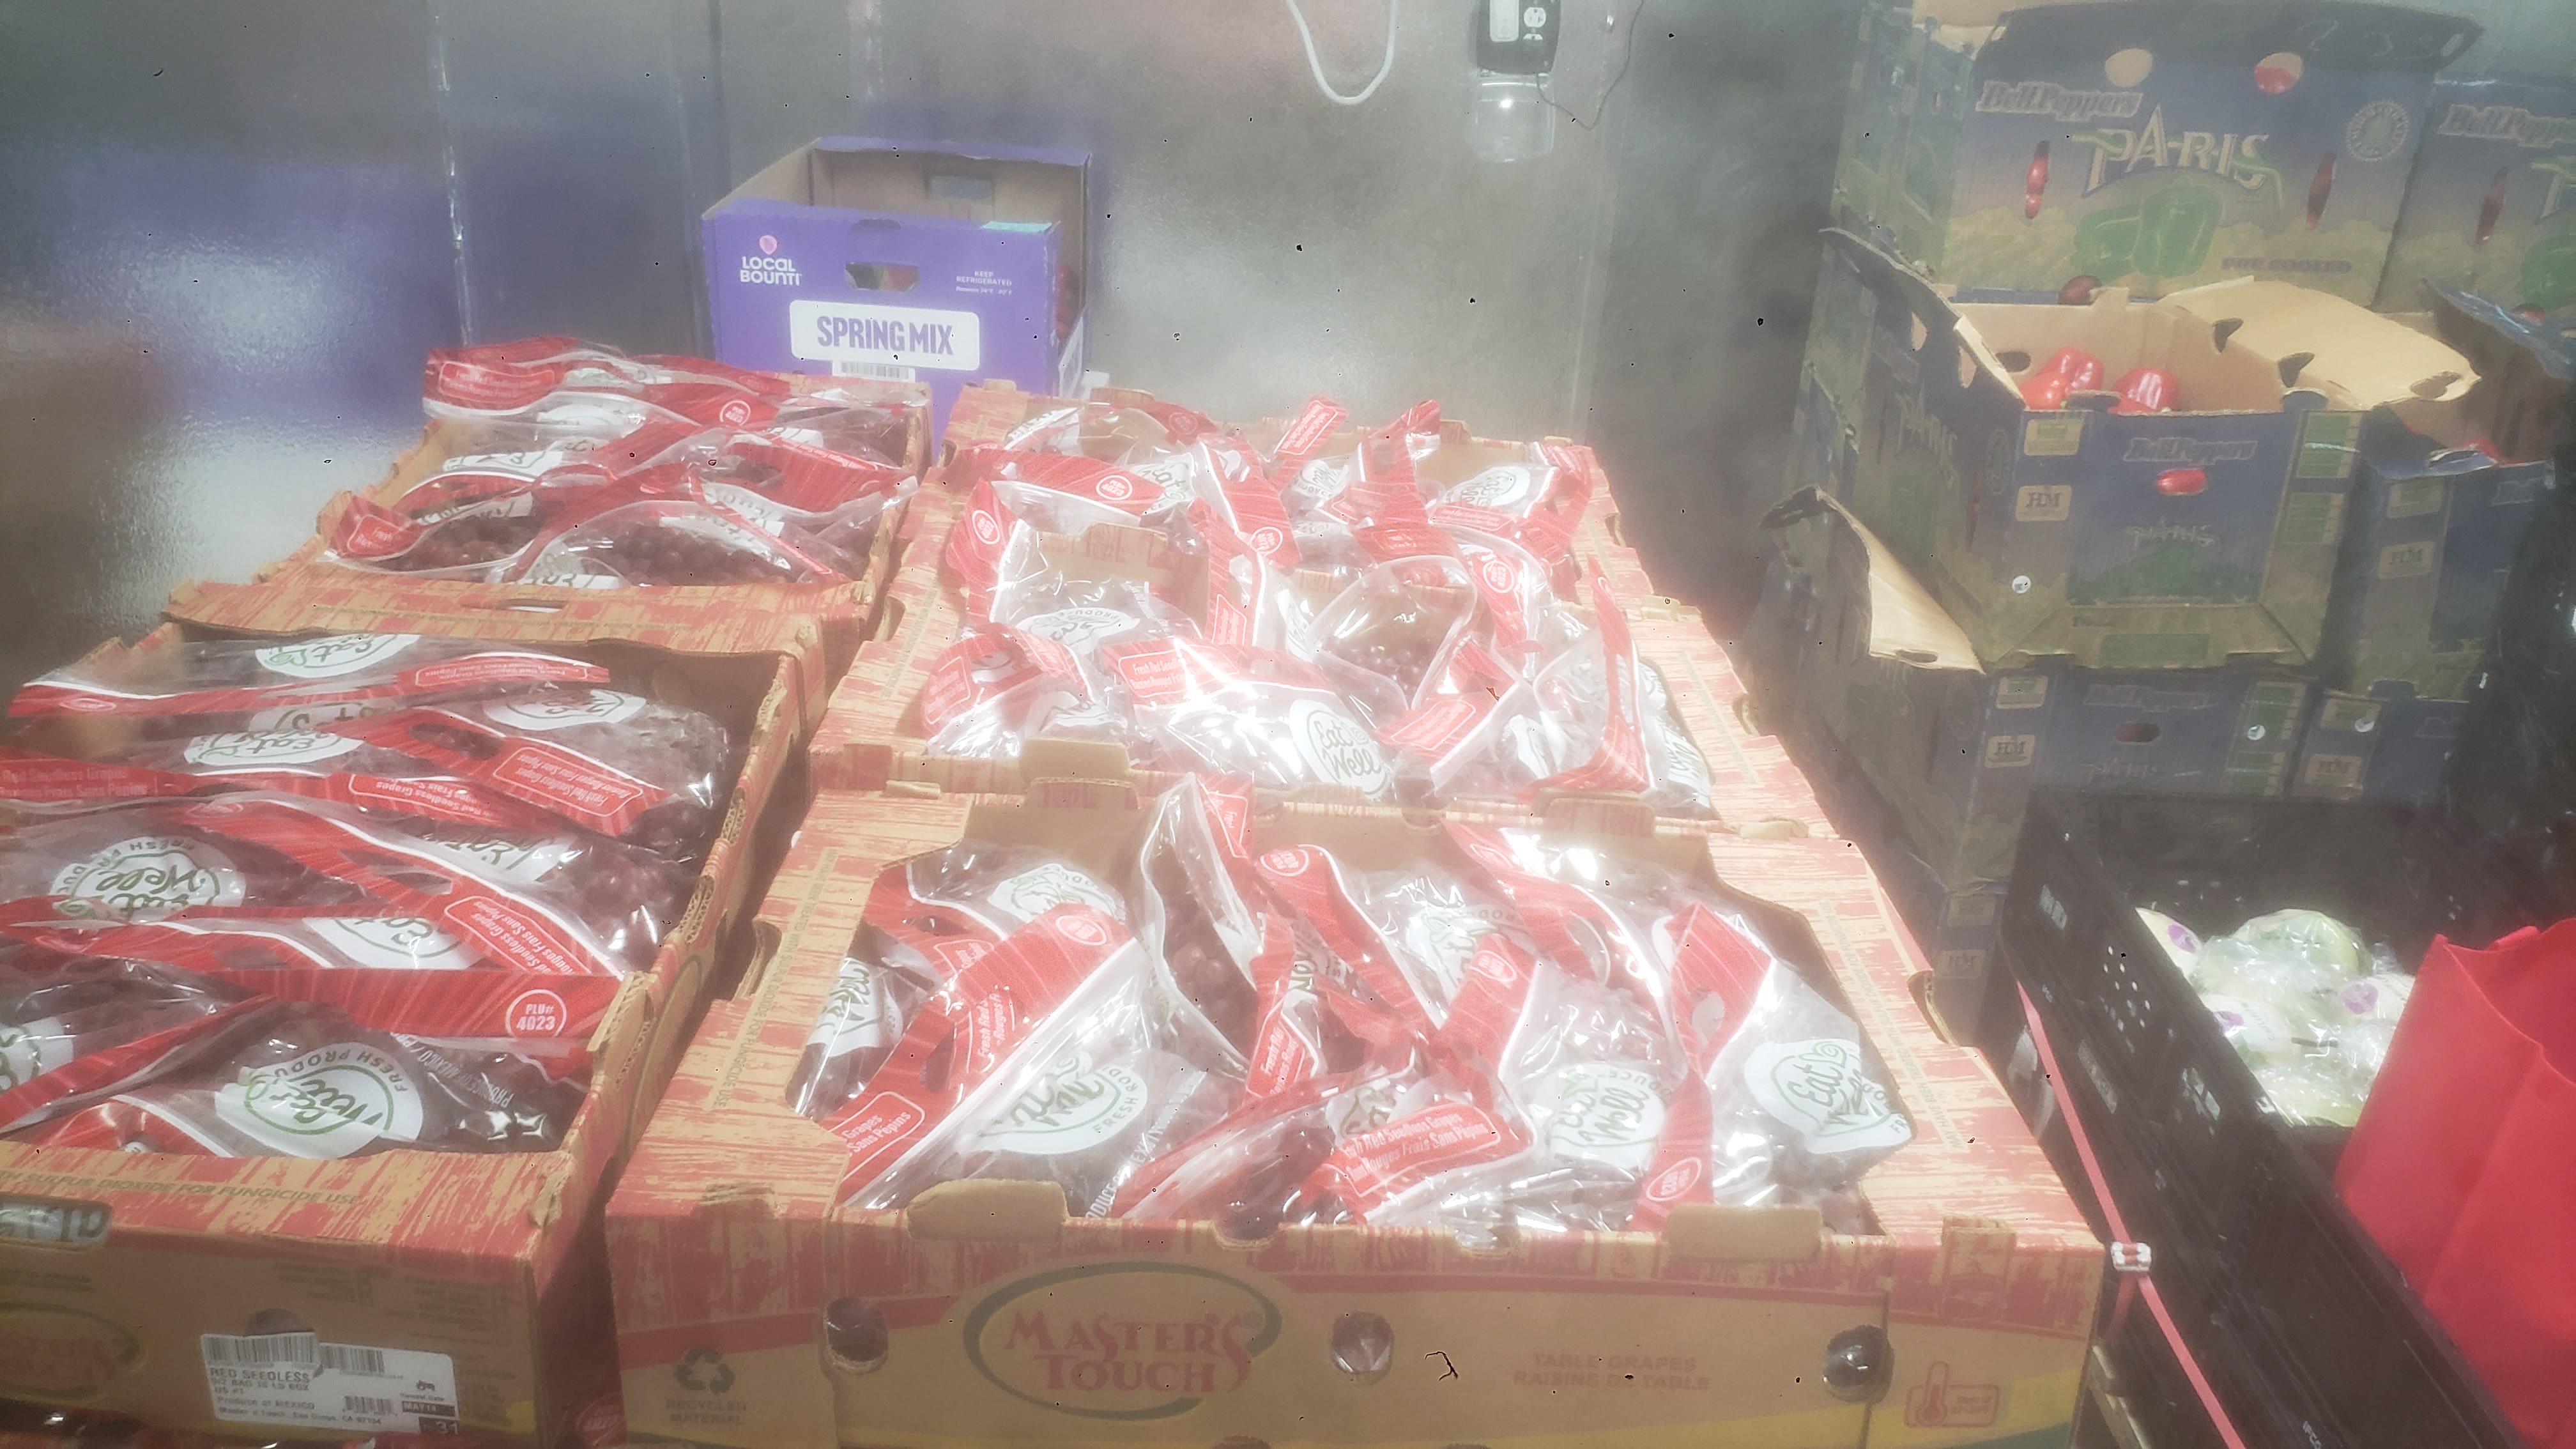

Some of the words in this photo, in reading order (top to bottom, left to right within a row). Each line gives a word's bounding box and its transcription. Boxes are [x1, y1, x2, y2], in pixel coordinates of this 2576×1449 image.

[2084, 102, 2270, 192] PARIS
[742, 255, 796, 272] LOCAL
[740, 269, 800, 286] BOUNTI
[956, 276, 1012, 286] REFRIGERATED
[818, 316, 905, 354] SPRING
[908, 323, 953, 355] MIX
[2025, 491, 2062, 509] HM
[1133, 662, 1149, 675] Fresh
[246, 735, 314, 755] Eat
[1313, 718, 1354, 750] Eat
[1995, 740, 2026, 756] HM
[1321, 747, 1382, 781] Well
[375, 780, 415, 798] Grapes
[415, 789, 466, 814] Seedless
[584, 788, 607, 806] Fresh
[95, 864, 204, 896] Well
[470, 912, 504, 937] Grapes
[503, 915, 526, 937] Sans
[794, 902, 816, 931] TREATED
[499, 933, 540, 967] Seedless
[521, 930, 546, 954] Frais
[525, 1002, 555, 1016] PLU#
[756, 984, 780, 1018] DIOXIDE
[516, 1015, 556, 1032] 4023
[744, 1018, 763, 1038] FOR
[977, 1004, 990, 1028] Red
[994, 1000, 1007, 1041] Rouges
[977, 1026, 992, 1058] Fresh
[274, 1049, 351, 1081] PRODU
[356, 1050, 408, 1093] FRESH
[418, 1048, 459, 1080] MEXICO
[723, 1036, 756, 1087] FUNGICIDE
[1261, 1042, 1278, 1076] Fresh
[1895, 1046, 1921, 1085] TREATED
[714, 1089, 733, 1107] USE
[1786, 1063, 1844, 1108] Eat
[1092, 1095, 1140, 1133] FRESH
[1577, 1086, 1650, 1142] Well
[1925, 1101, 1948, 1130] HAVE
[841, 1114, 884, 1140] Grapes
[1363, 1130, 1385, 1151] Red
[1384, 1121, 1431, 1142] Seedless
[1425, 1113, 1464, 1130] Grapes
[1429, 1130, 1459, 1147] Sans
[846, 1132, 878, 1153] Sans
[28, 1173, 95, 1188] SULFUR
[97, 1178, 176, 1193] DIOXIDE
[178, 1183, 215, 1195] FOR
[219, 1186, 323, 1204] FUNGICIDE
[324, 1193, 360, 1206] USE
[1004, 1310, 1252, 1393] MASTER'S
[1533, 1353, 1599, 1369] TABLE
[1607, 1355, 1697, 1372] GRAPES
[211, 1367, 237, 1379] RED
[242, 1370, 310, 1384] SEEDLESS
[1032, 1354, 1216, 1393] TOUCH
[1512, 1371, 1600, 1388] RAISINS
[1641, 1374, 1710, 1391] TABLE
[215, 1386, 230, 1395] US
[217, 1395, 257, 1406] Produce
[274, 1399, 315, 1410] MEXICO
[665, 1399, 747, 1412] RECYCLED
[670, 1412, 744, 1424] MATERIAL
